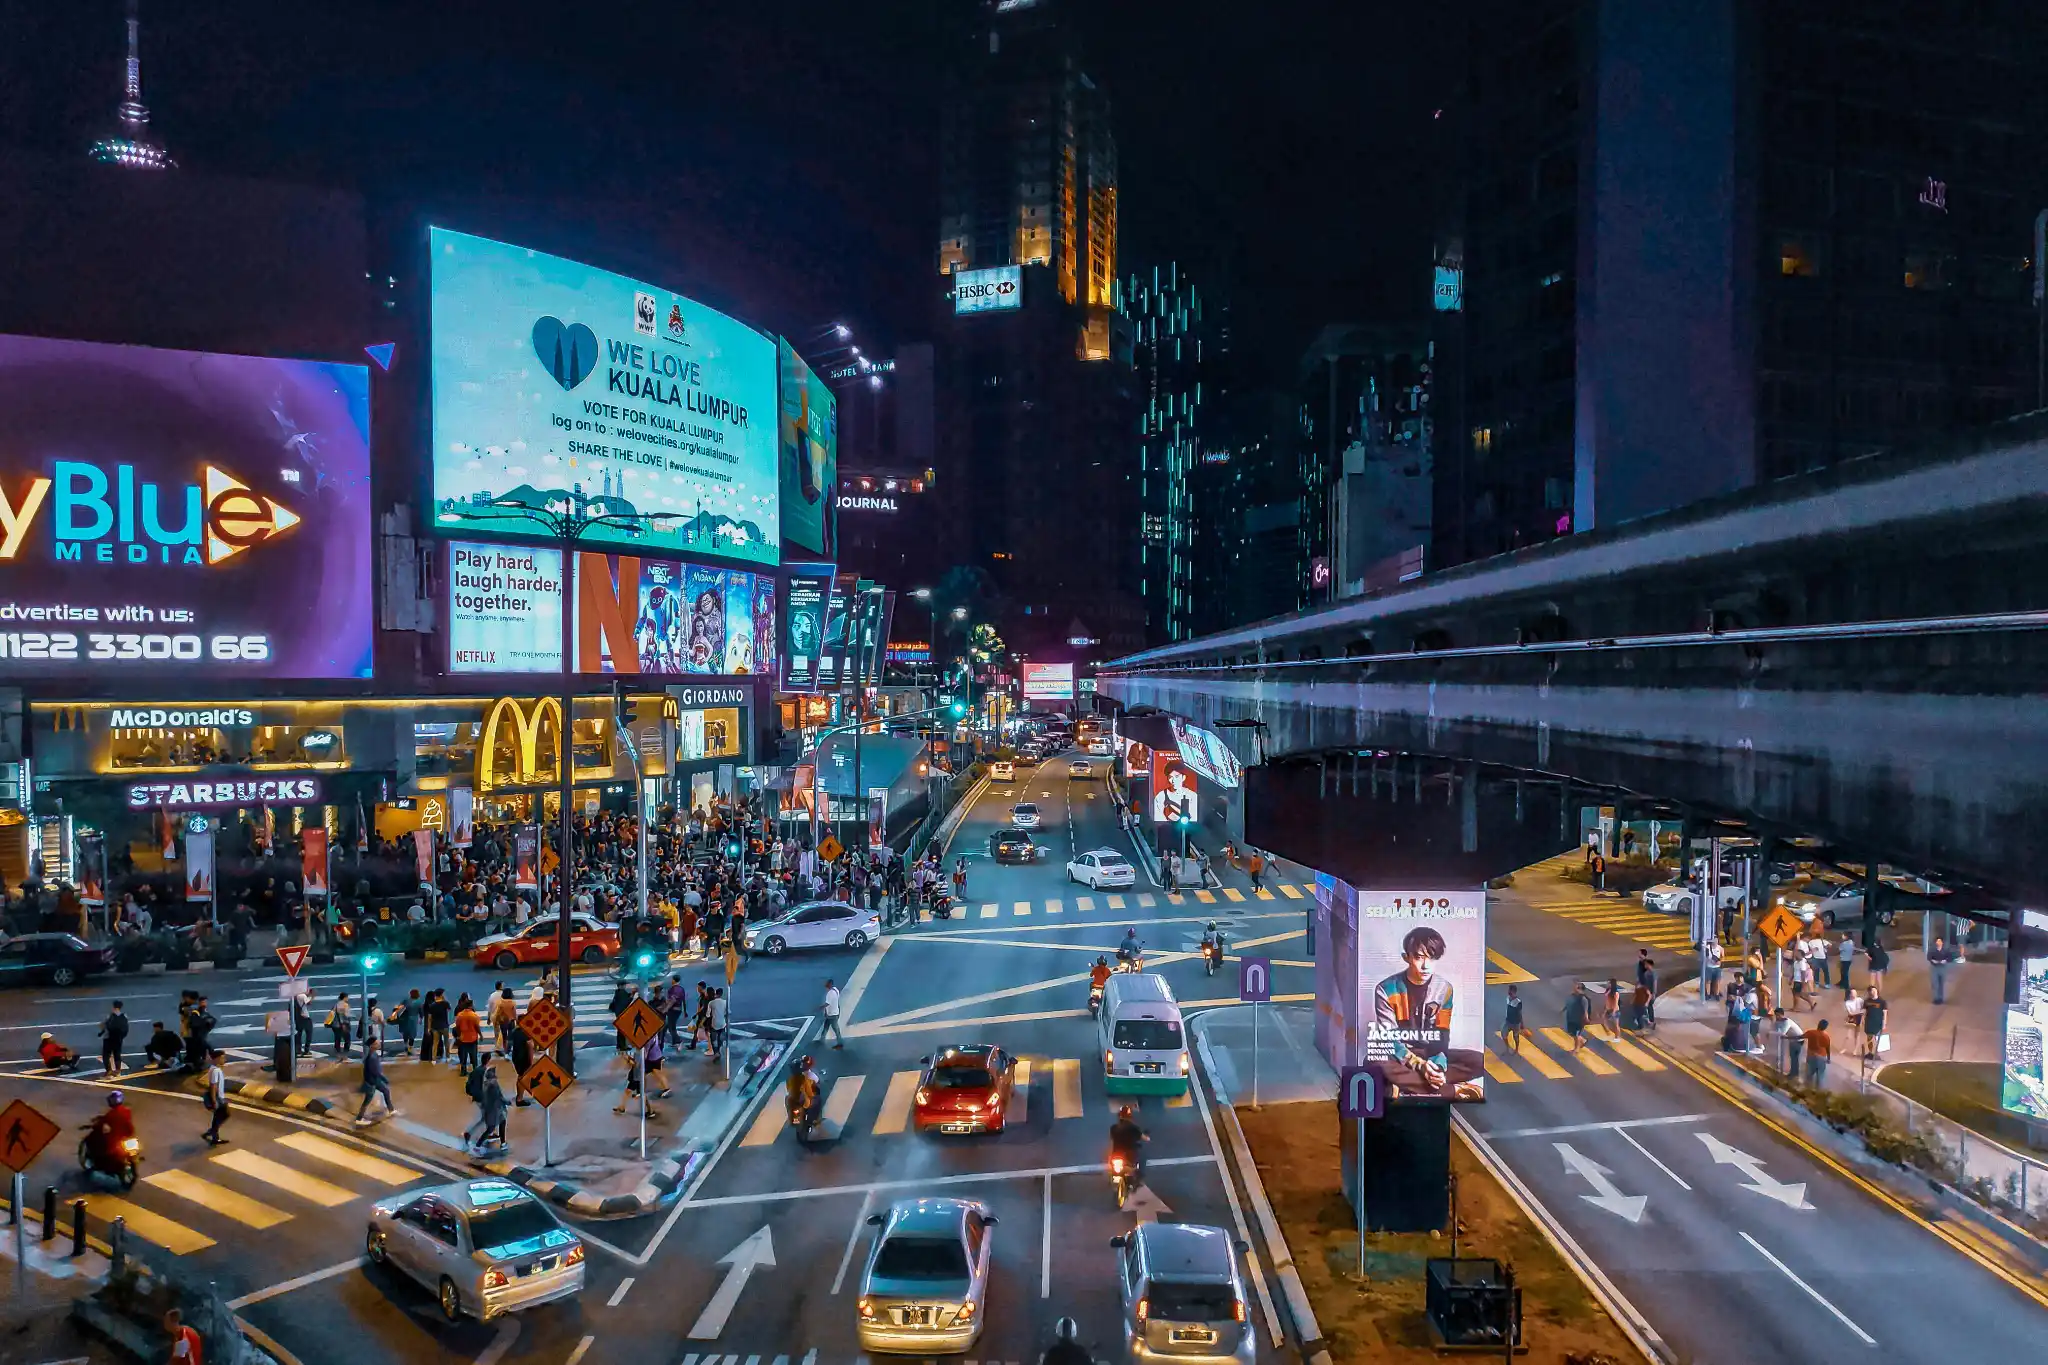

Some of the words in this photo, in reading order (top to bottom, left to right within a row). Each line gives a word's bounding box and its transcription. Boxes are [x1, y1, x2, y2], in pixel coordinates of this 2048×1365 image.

[959, 283, 995, 299] HSBC
[638, 322, 655, 333] WWF
[607, 338, 644, 370] WE
[651, 350, 701, 386] LOVE
[609, 367, 682, 409] KUALA
[687, 388, 749, 429] LUMPUR
[552, 413, 572, 432] log
[576, 421, 591, 432] on
[595, 422, 606, 434] to
[583, 399, 619, 420] VOTE
[622, 408, 648, 426] FOR
[650, 414, 687, 435] KUALA
[688, 422, 724, 445] LUMPUR
[568, 440, 609, 458] SHARE
[612, 447, 634, 463] THE
[636, 451, 663, 468] LOVE
[836, 496, 898, 510] JOURNAL
[56, 542, 203, 565] MEDIA
[455, 550, 492, 571] Play
[496, 552, 538, 574] hard,
[647, 565, 670, 576] NEXT
[455, 571, 502, 593] laugh
[507, 575, 562, 596] harder,
[455, 593, 532, 613] together.
[104, 606, 154, 622] with
[160, 608, 194, 623] us:
[89, 635, 201, 659] 3300
[211, 636, 268, 660] 66
[456, 651, 496, 664] NETFLIX
[682, 689, 744, 705] GIORDANO
[110, 708, 253, 727] McDonald's
[130, 780, 317, 806] STARBUCKS
[1367, 1030, 1418, 1041] JACKSON
[1421, 1030, 1441, 1041] YEE
